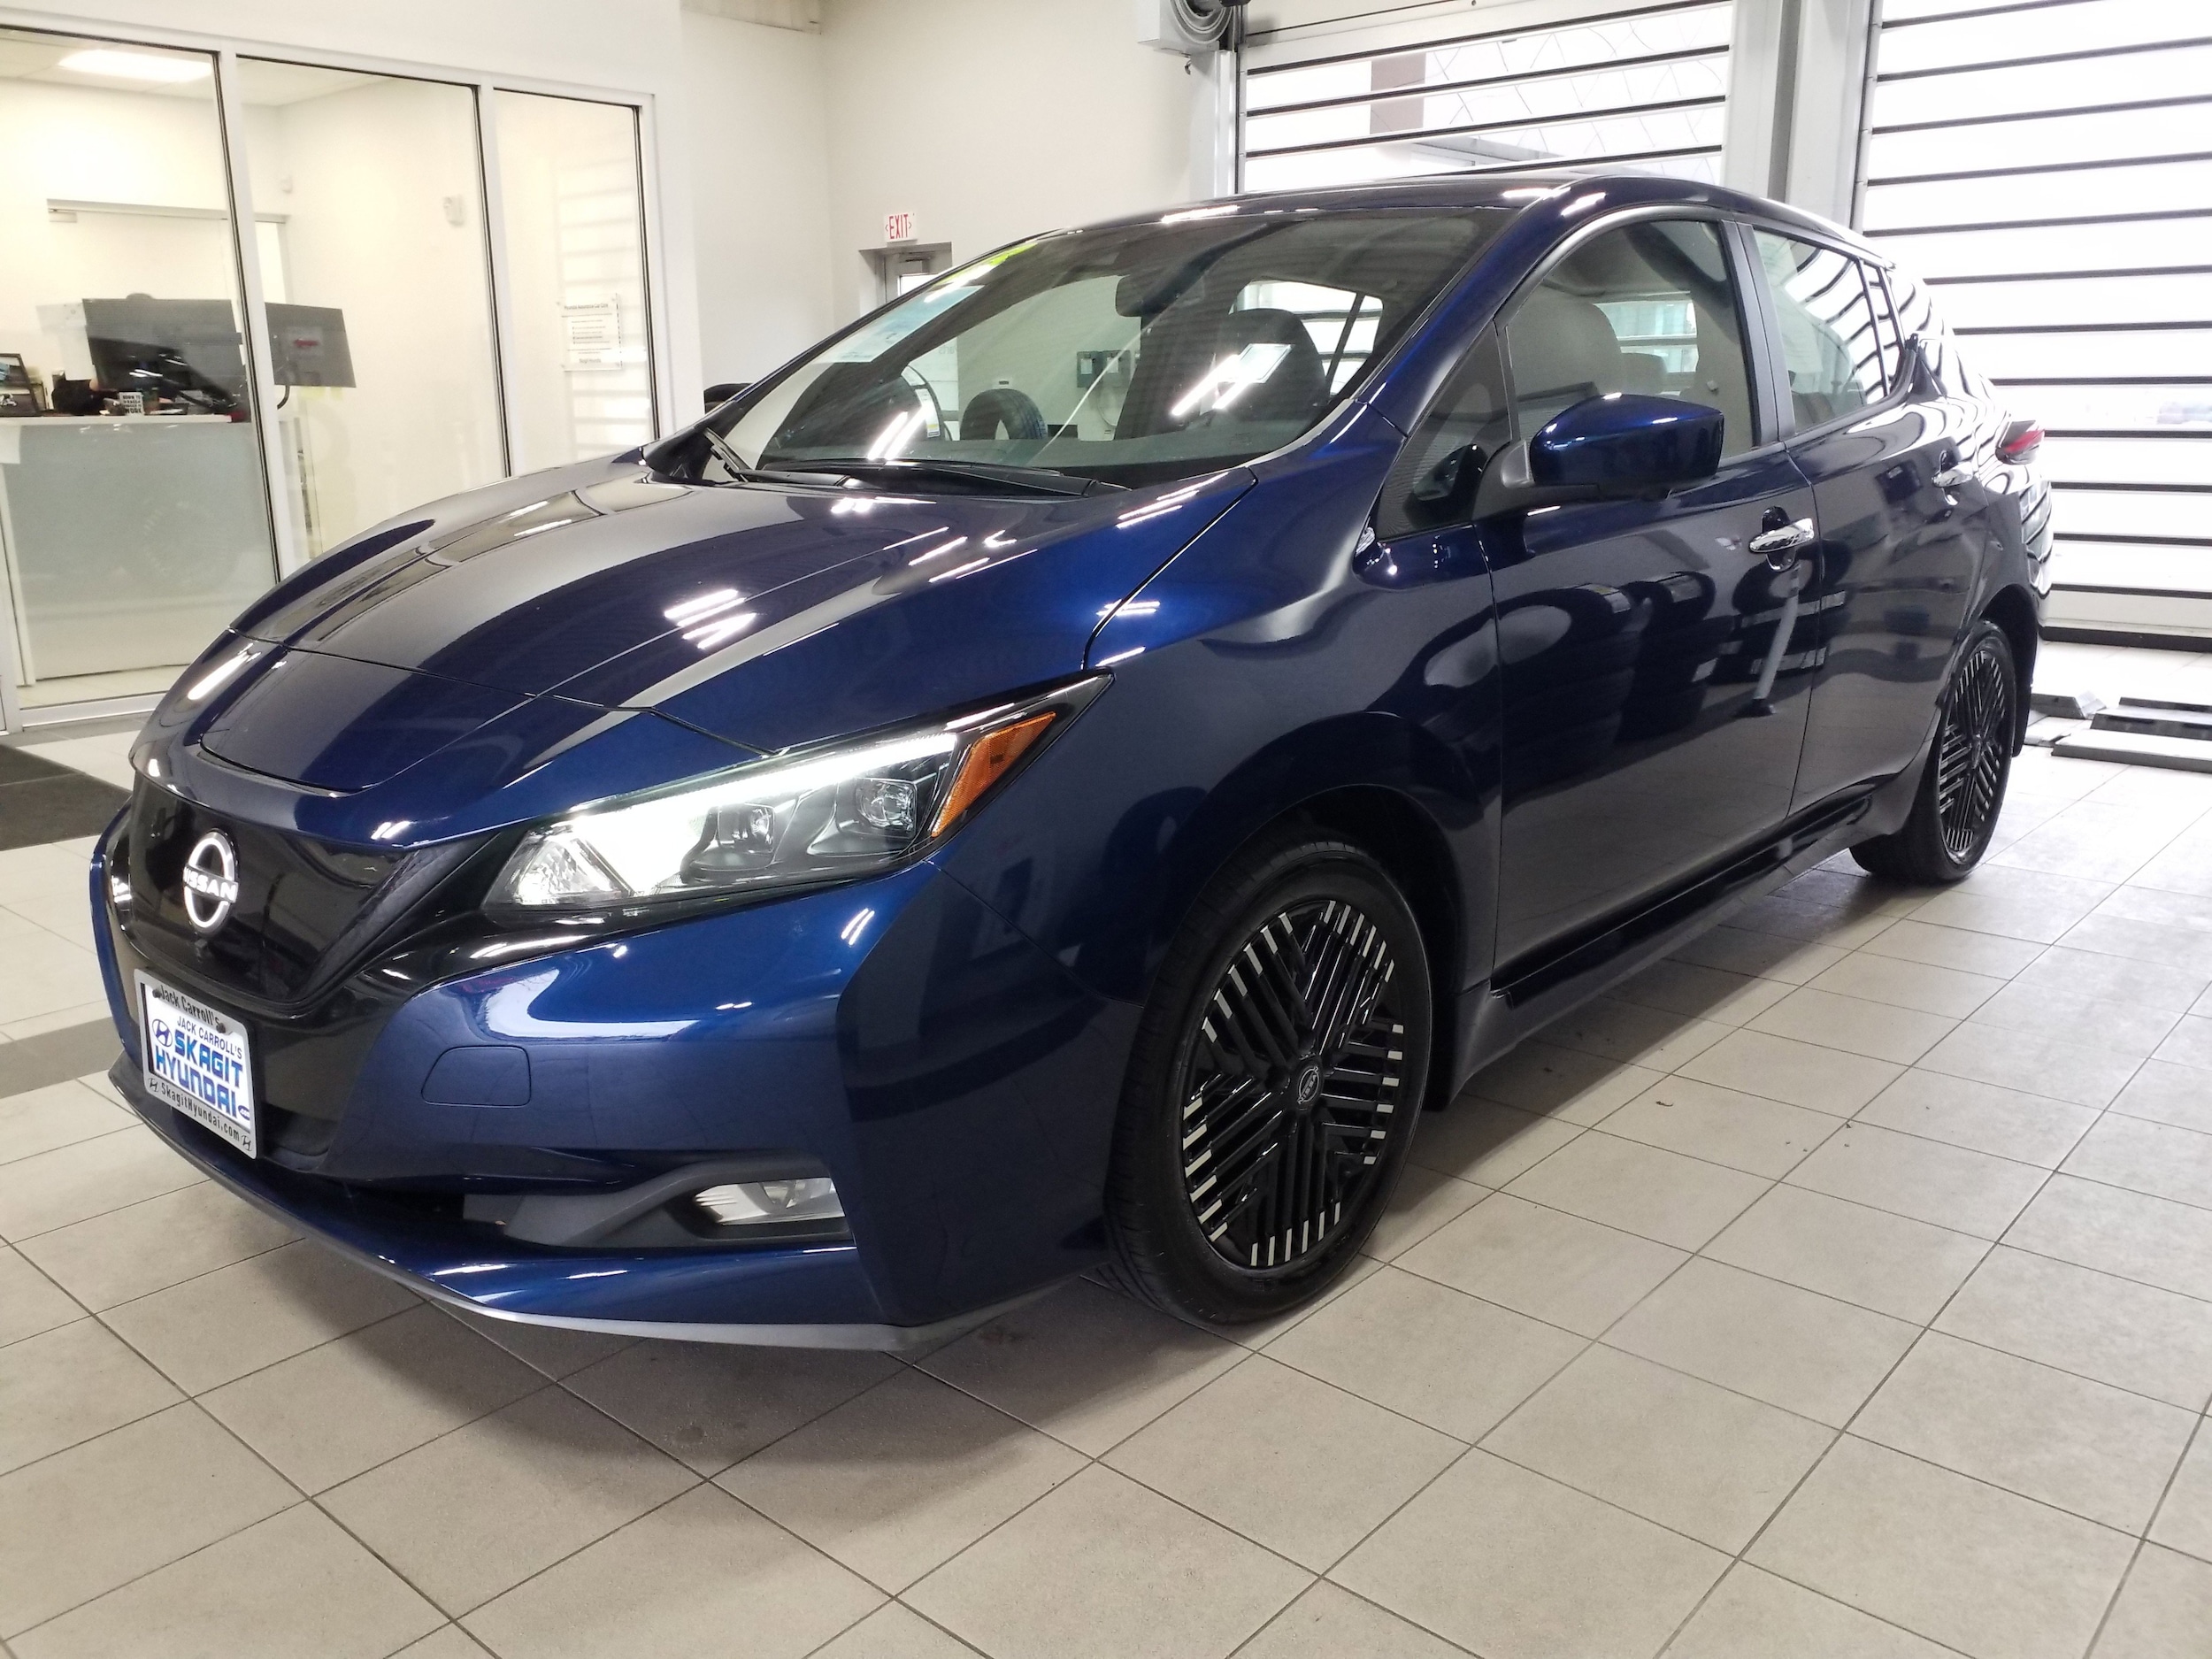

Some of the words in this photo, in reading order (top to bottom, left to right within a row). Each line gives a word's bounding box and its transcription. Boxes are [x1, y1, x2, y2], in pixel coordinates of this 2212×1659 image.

[888, 213, 909, 240] EXIT
[183, 866, 237, 902] NISSAN
[160, 985, 180, 1007] Jack
[174, 1029, 243, 1088] SKAGIT
[177, 1016, 196, 1035] JACK
[198, 1027, 242, 1059] CARROLL'S
[155, 1046, 237, 1119] HYUNDAI
[160, 1083, 240, 1142] SkagitHyundai.com
